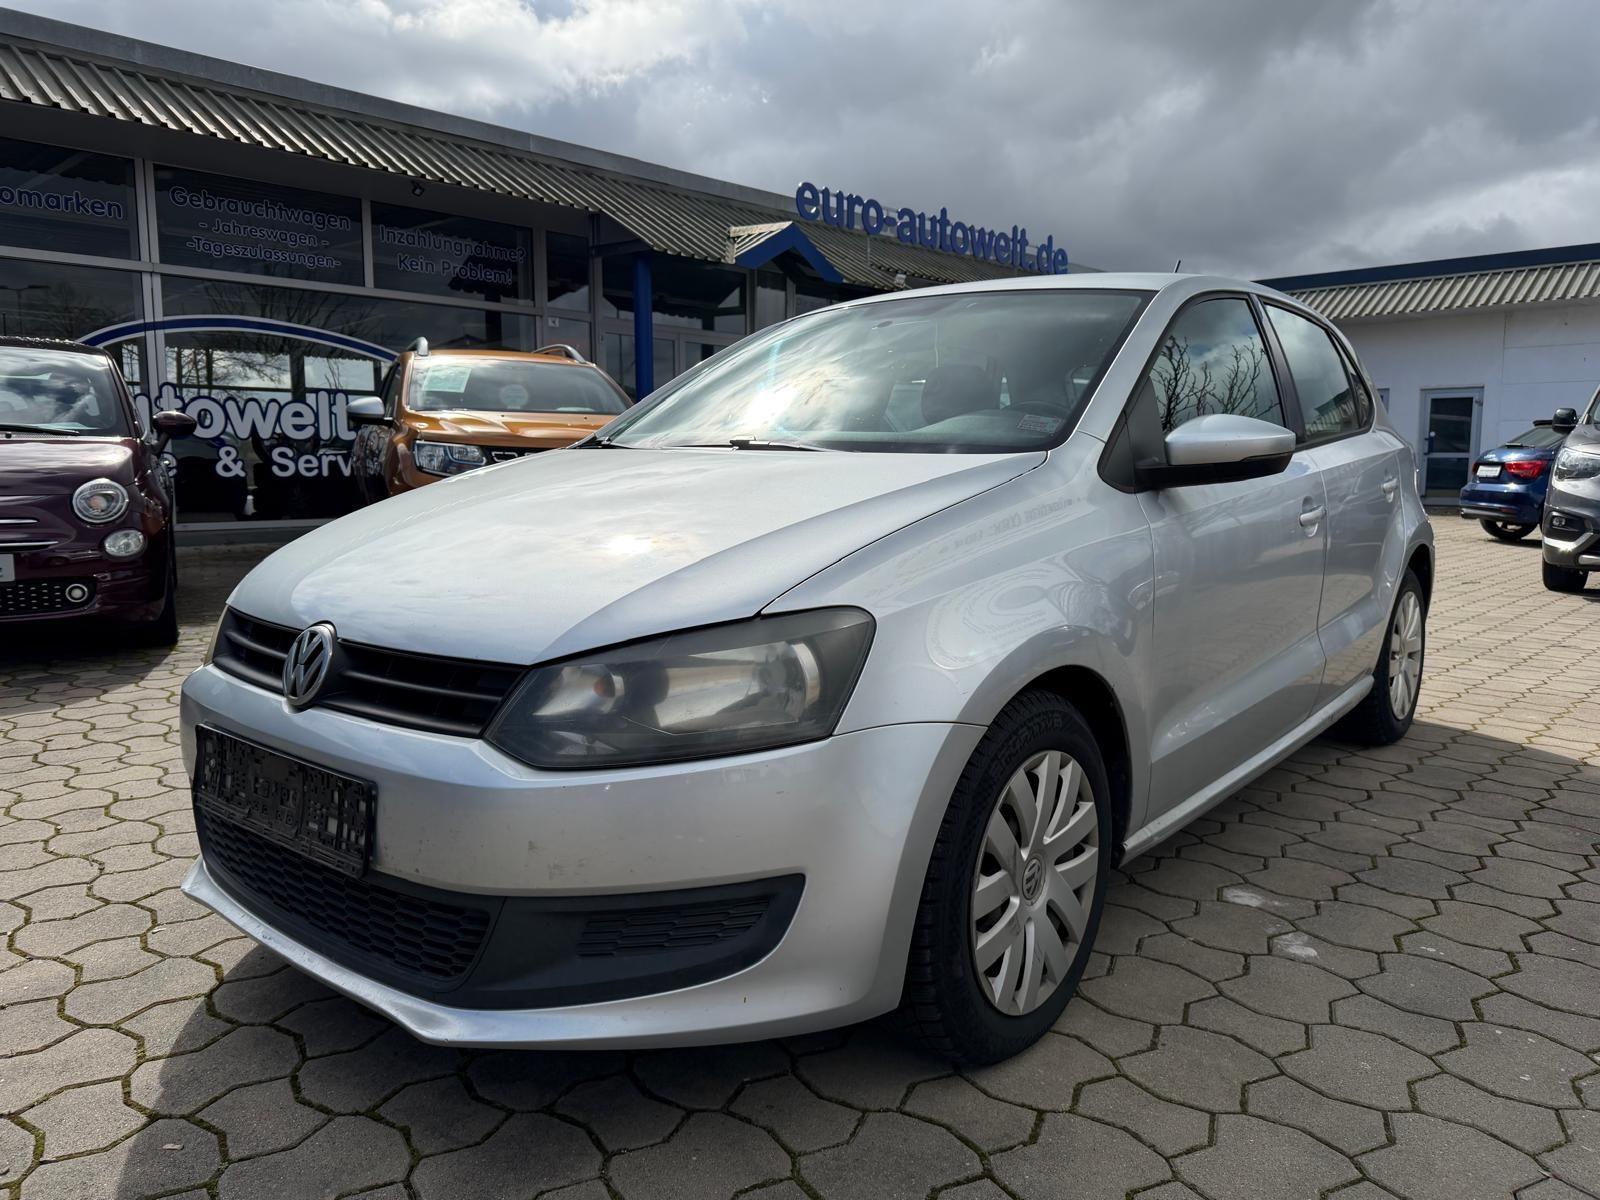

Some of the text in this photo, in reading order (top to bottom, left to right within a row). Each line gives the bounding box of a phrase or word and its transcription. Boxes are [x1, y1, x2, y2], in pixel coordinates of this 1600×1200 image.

[169, 186, 350, 231] Gebrauchtwagen
[212, 219, 318, 247] Jahreswagen
[379, 224, 526, 263] Inzahlungnahme?
[796, 182, 1068, 275] euro-autowelt.de
[186, 236, 342, 269] -Tageszulassungen-
[397, 254, 513, 285] Kein Problem!
[215, 446, 246, 478] &
